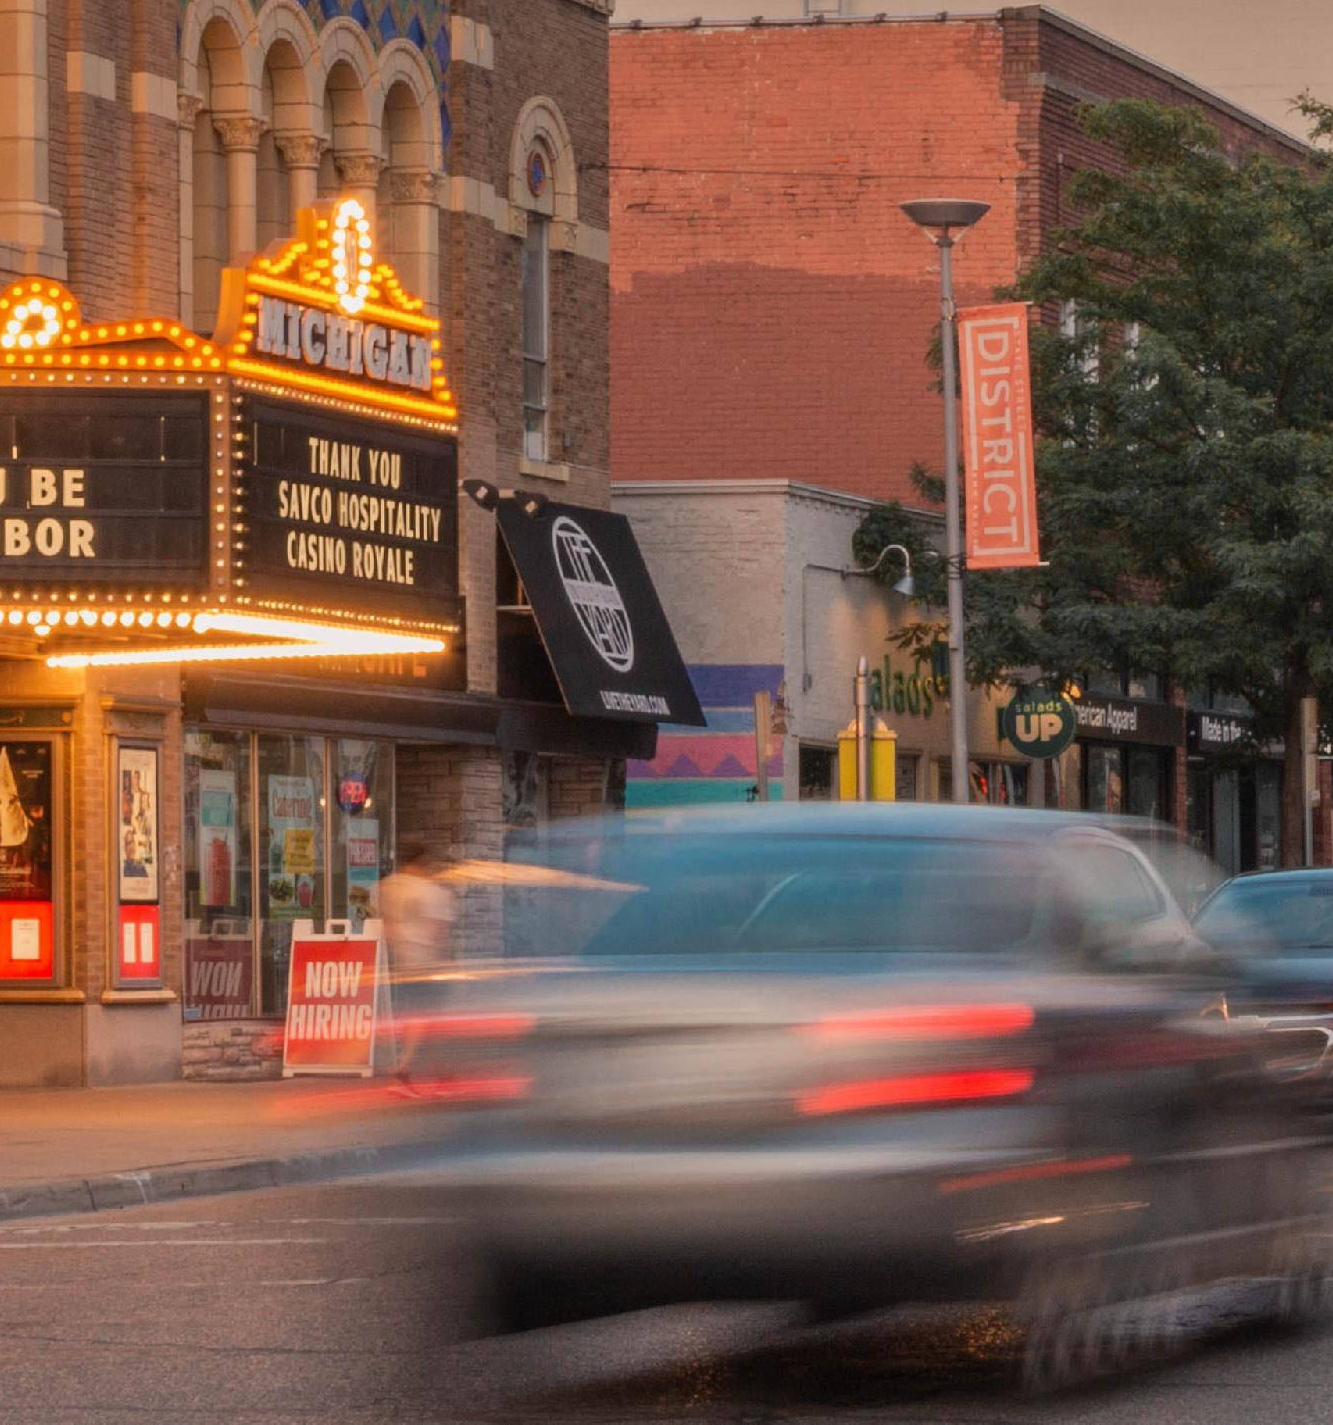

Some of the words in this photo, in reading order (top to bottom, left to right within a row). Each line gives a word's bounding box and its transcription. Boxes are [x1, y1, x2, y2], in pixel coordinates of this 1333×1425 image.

[257, 295, 432, 391] MICHIGAN
[309, 436, 361, 481] THANK
[369, 449, 401, 489] YOU
[977, 331, 1018, 543] DISTRICT
[30, 468, 86, 507] BE
[279, 480, 332, 524] SAVCO
[339, 491, 441, 542] HOSPITALITY
[287, 530, 346, 575] CASINO
[353, 541, 414, 585] ROYALE
[871, 655, 934, 717] alads
[1015, 700, 1063, 713] salads
[1015, 714, 1063, 743] UP
[305, 961, 365, 998] NOW
[290, 1004, 374, 1040] HIRING
